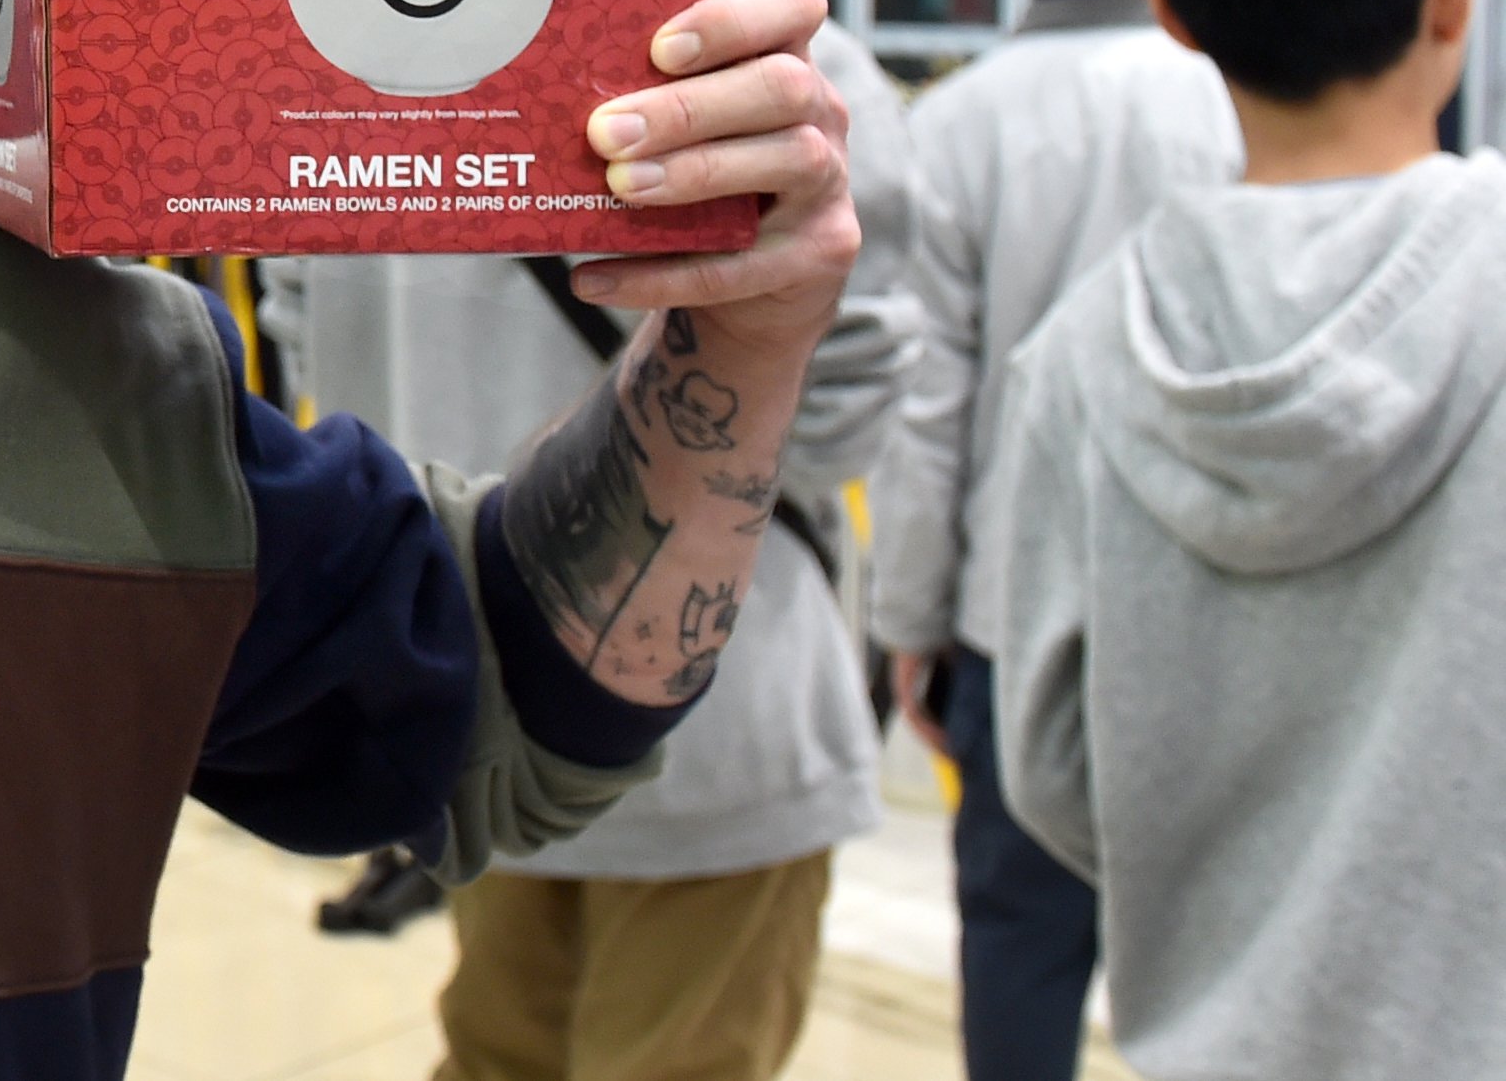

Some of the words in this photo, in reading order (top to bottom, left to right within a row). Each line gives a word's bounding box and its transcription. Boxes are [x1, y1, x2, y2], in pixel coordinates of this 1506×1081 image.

[289, 154, 444, 188] RAMEN
[455, 153, 536, 188] SET
[166, 197, 252, 213] CONTAINS
[255, 198, 266, 213] 2
[269, 197, 332, 212] RAMEN
[335, 197, 397, 212] BOWLS
[400, 196, 437, 212] AND
[440, 196, 452, 212] 2
[455, 196, 506, 211] PAIRS
[508, 196, 532, 211] OF
[535, 195, 644, 212] CHOPSTIC
